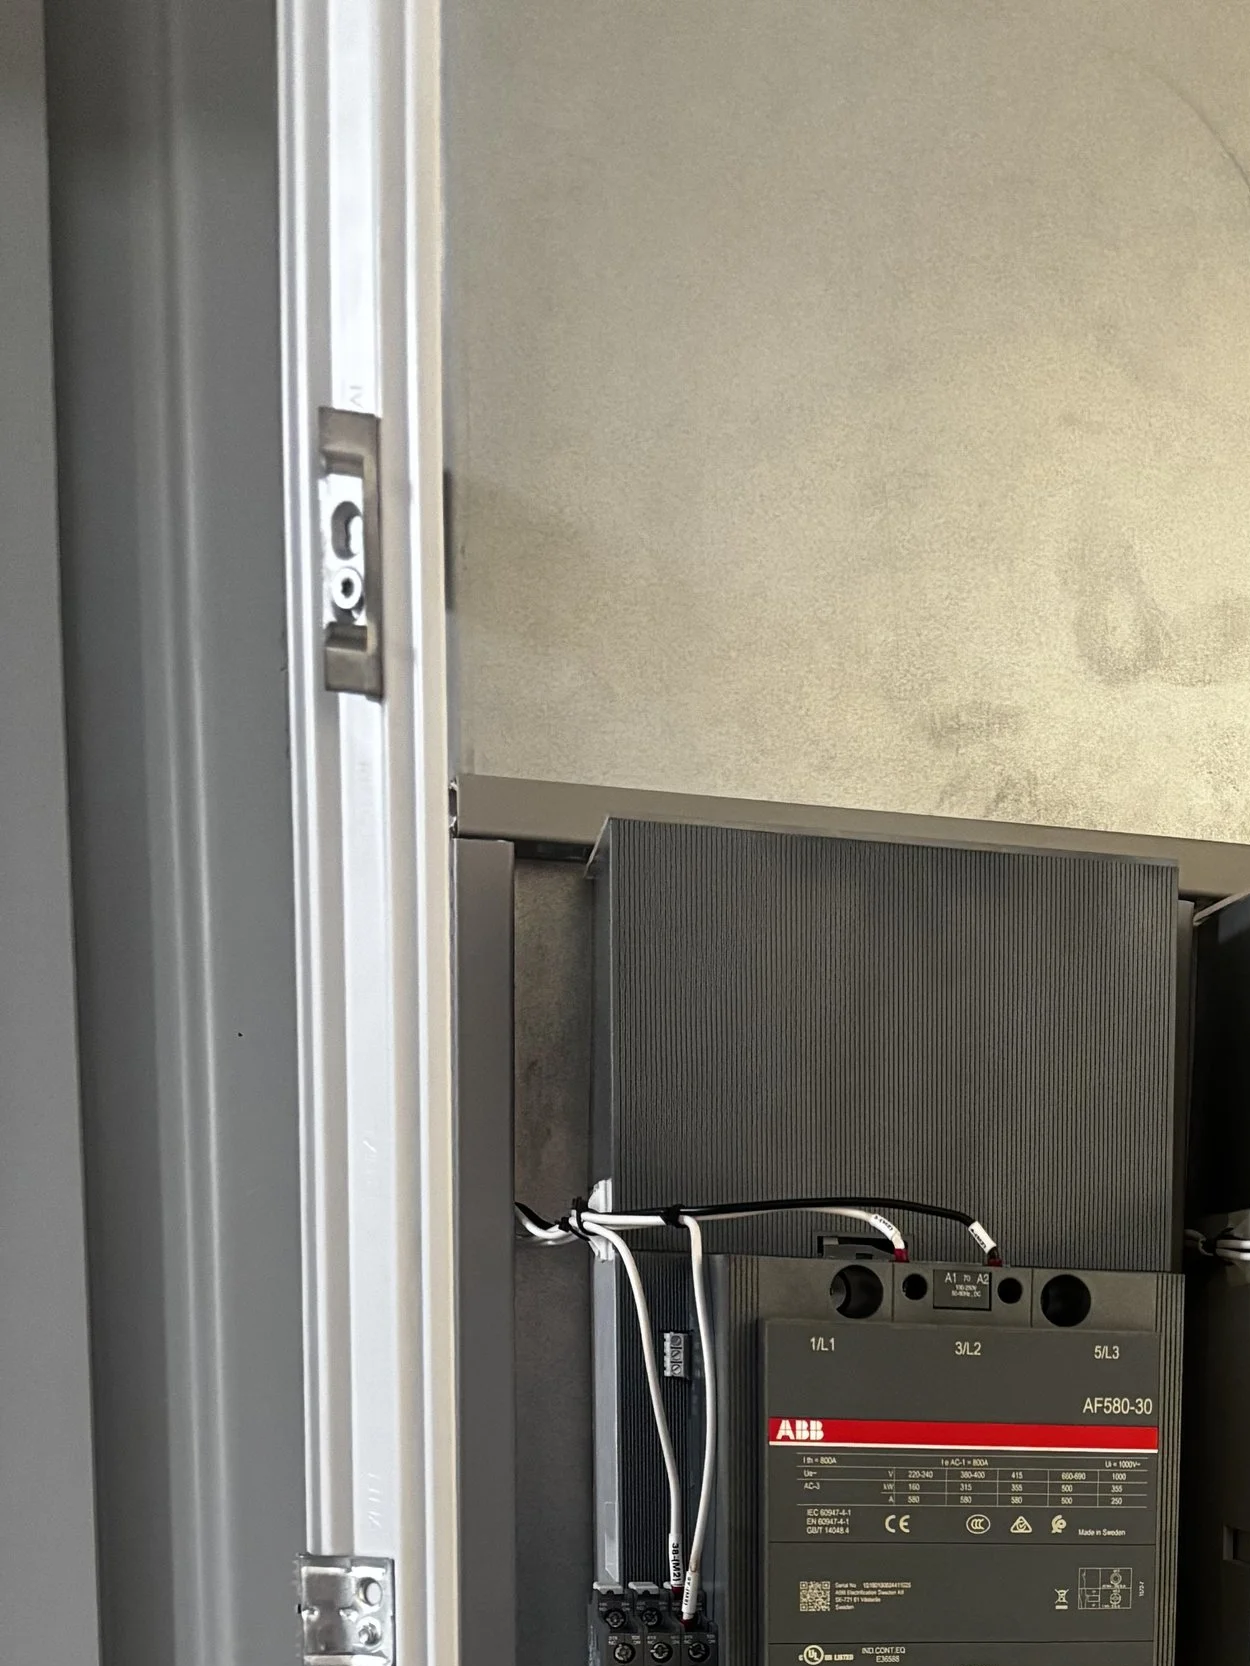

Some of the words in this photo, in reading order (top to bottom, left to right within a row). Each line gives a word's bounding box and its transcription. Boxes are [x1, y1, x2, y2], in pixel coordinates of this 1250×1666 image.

[945, 1272, 957, 1284] A1
[977, 1273, 990, 1285] A2
[810, 1338, 835, 1351] 1/L1
[955, 1342, 981, 1356] 3/L2
[1094, 1346, 1120, 1360] 5/L3
[1083, 1398, 1153, 1415] AF580-30
[776, 1419, 825, 1441] ABB
[960, 1471, 985, 1479] 380-400
[1011, 1471, 1023, 1479] 415
[1061, 1472, 1086, 1480] 660-690
[1112, 1473, 1126, 1481] 1000
[1011, 1484, 1023, 1492] 355
[1061, 1484, 1073, 1492] 500
[1111, 1485, 1123, 1493] 355
[960, 1496, 972, 1504] 580
[1011, 1496, 1023, 1504] 580
[1061, 1497, 1073, 1505] 500
[1111, 1497, 1122, 1505] 250
[885, 1514, 910, 1533] CE
